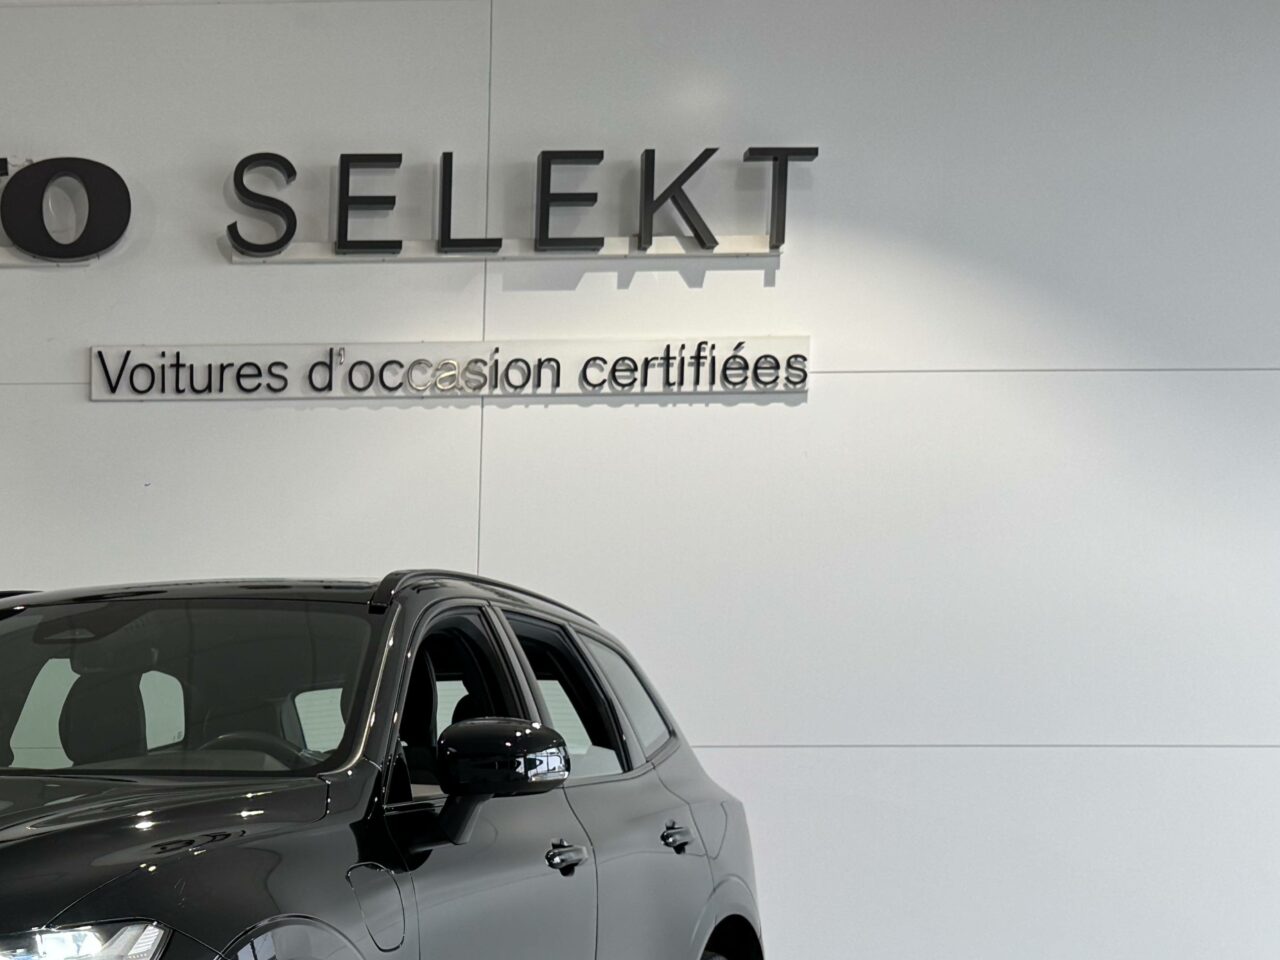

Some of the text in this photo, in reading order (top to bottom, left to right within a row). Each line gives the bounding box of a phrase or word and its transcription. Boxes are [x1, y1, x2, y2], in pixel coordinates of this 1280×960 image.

[227, 147, 819, 258] SELEKT
[97, 341, 808, 394] Voitures d'occasion certifiées
